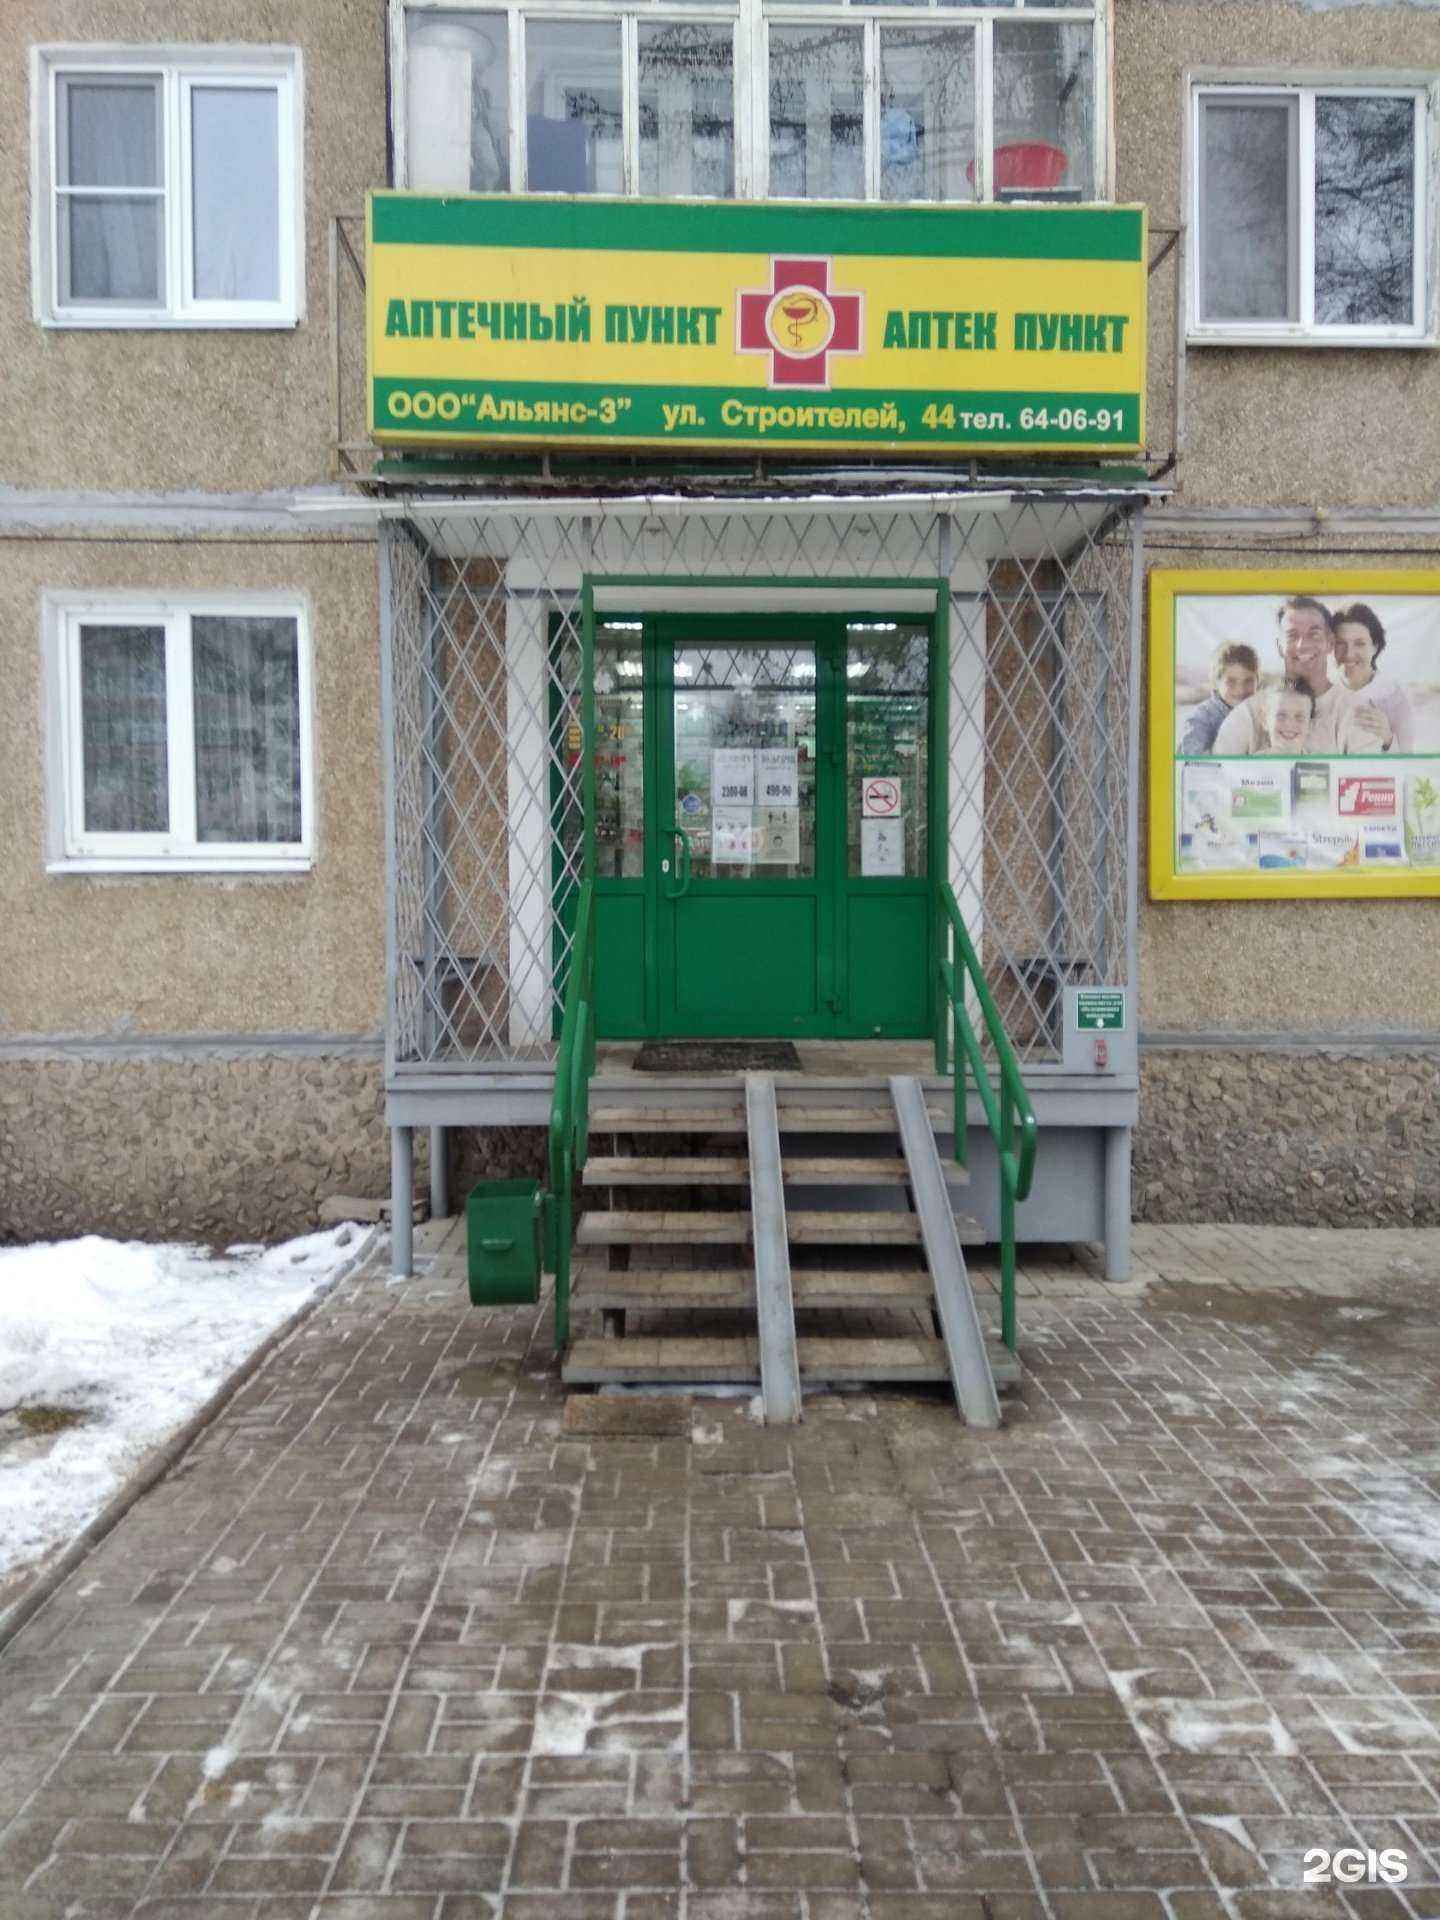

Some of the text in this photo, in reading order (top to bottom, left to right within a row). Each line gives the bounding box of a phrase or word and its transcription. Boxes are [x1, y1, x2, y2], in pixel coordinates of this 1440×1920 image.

[385, 296, 722, 345] АПТЕЧНЫЙ ПУНКТ
[882, 310, 1130, 353] АПТЕК ПУНКТ
[661, 402, 706, 432] ул.
[720, 399, 906, 434] Строителей,
[921, 403, 956, 429] 44
[960, 411, 1012, 431] тел.
[1019, 407, 1125, 432] 64-06-91
